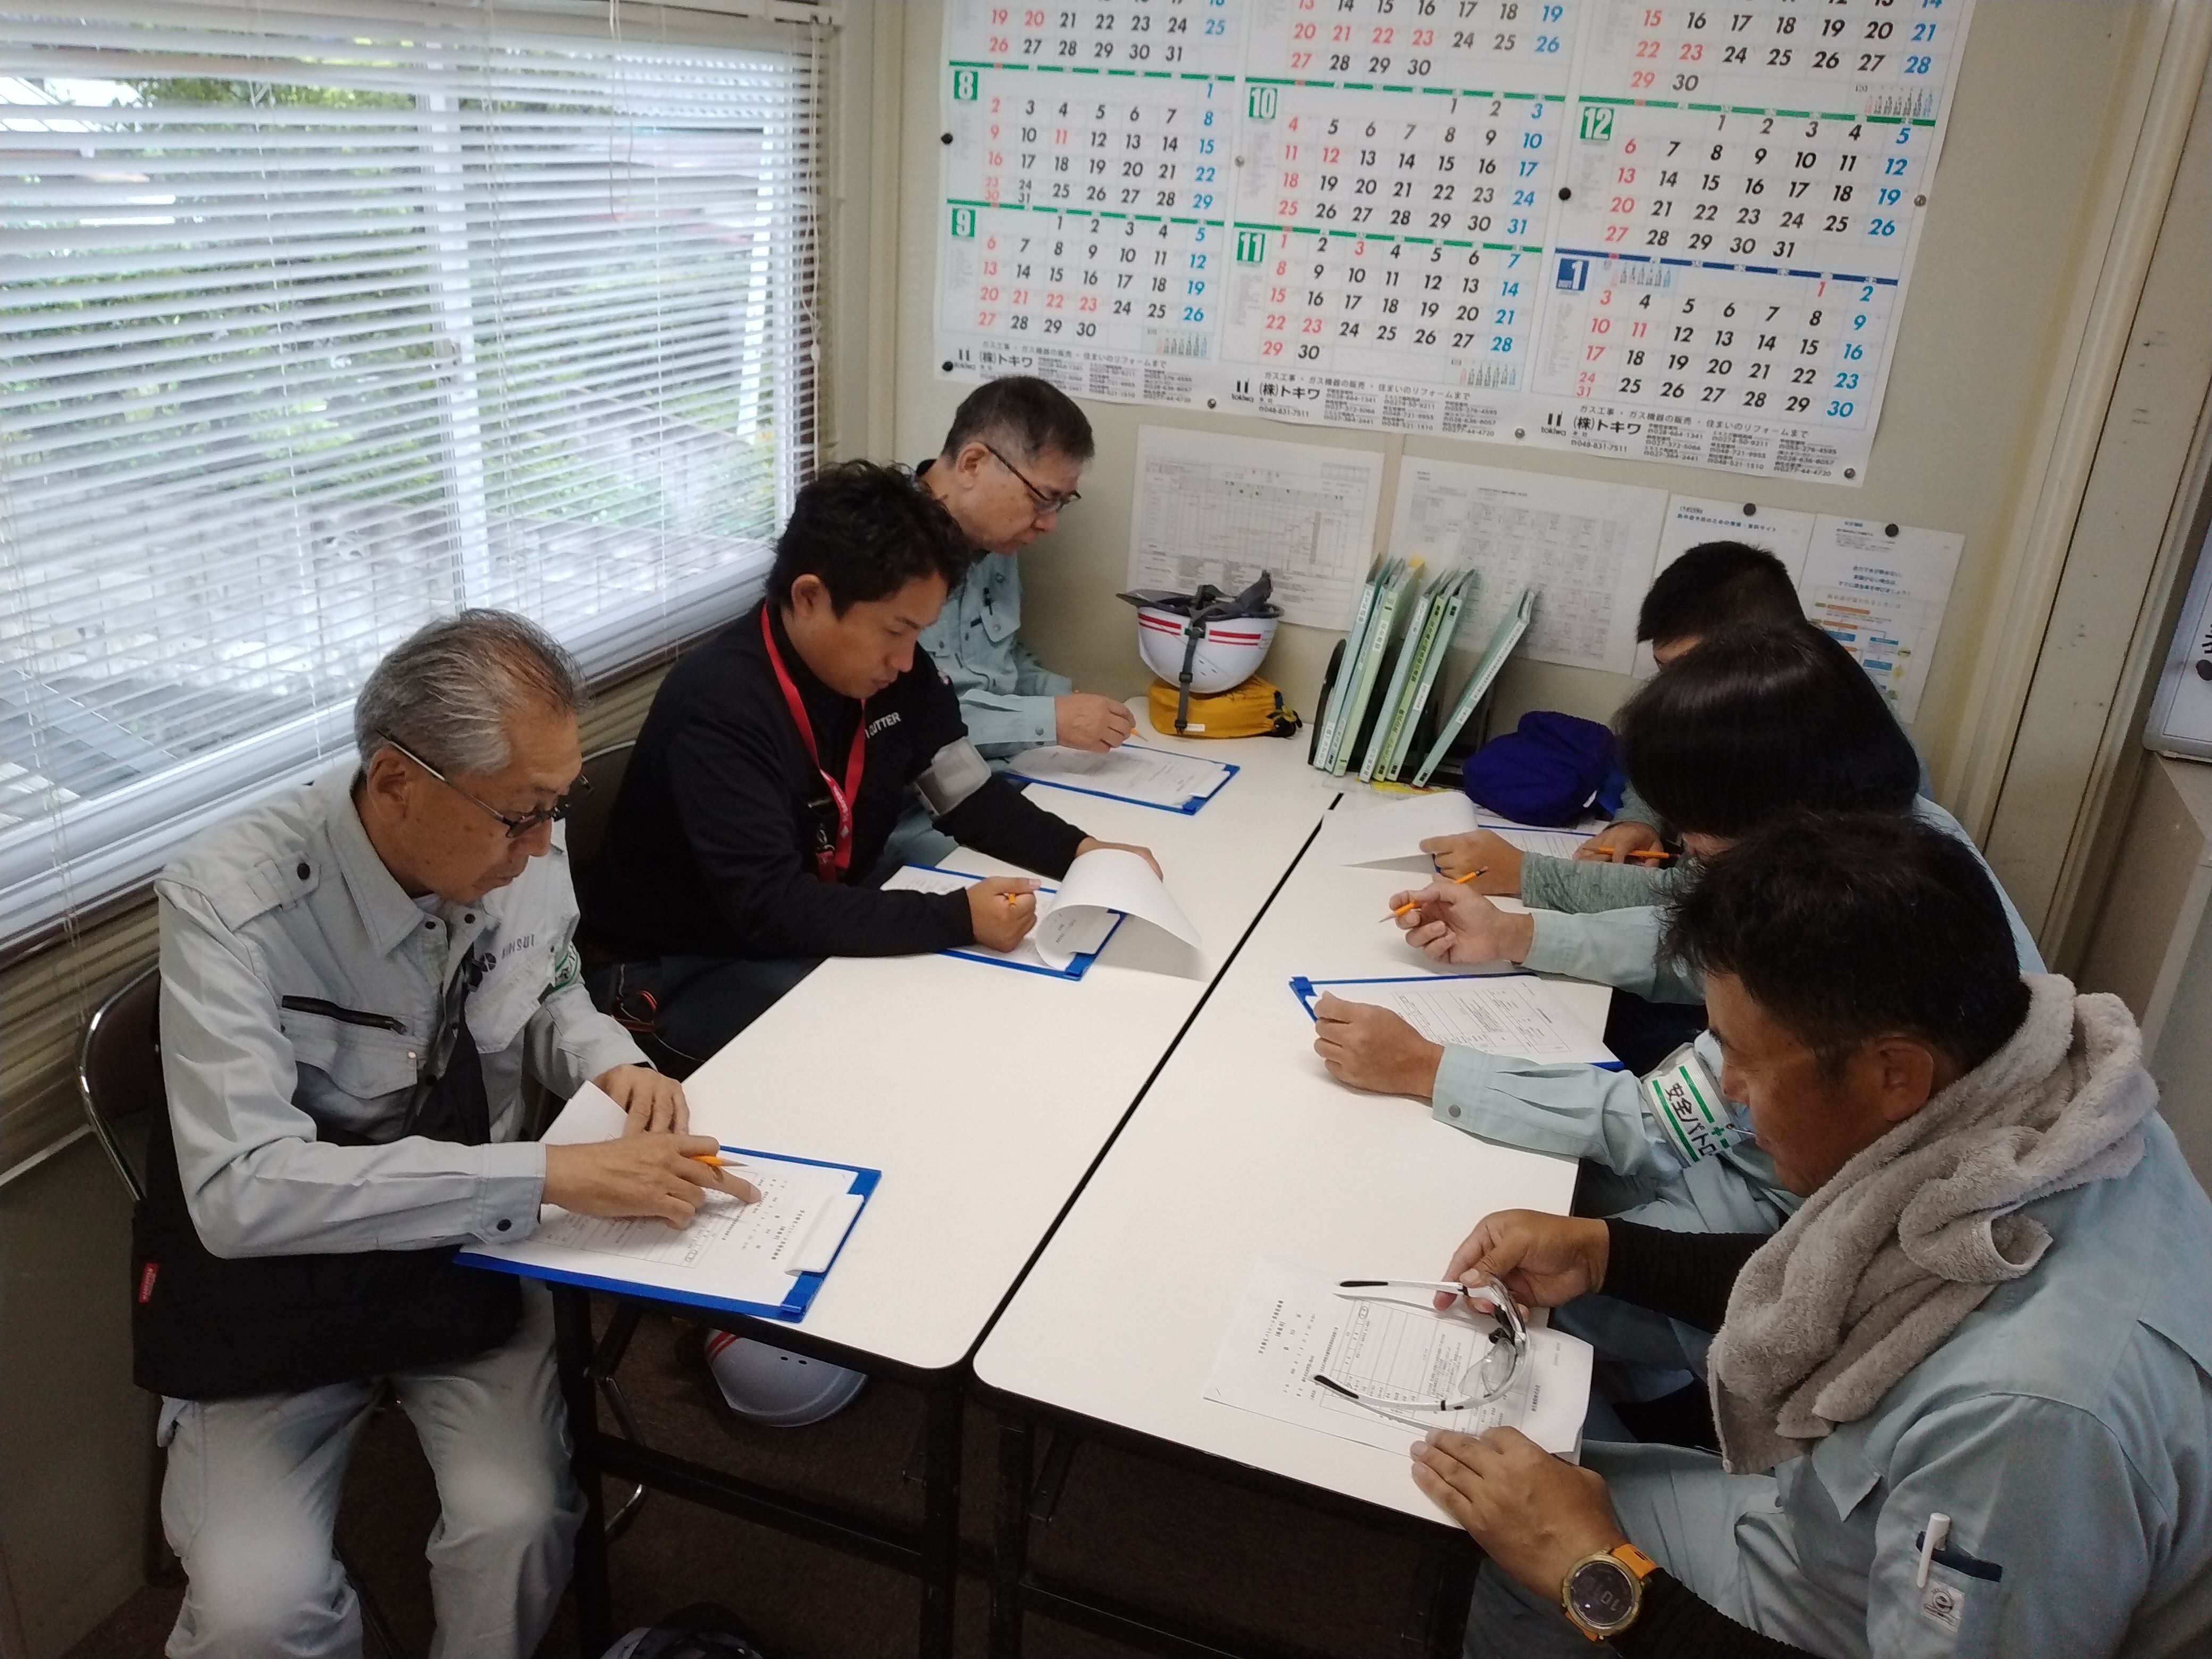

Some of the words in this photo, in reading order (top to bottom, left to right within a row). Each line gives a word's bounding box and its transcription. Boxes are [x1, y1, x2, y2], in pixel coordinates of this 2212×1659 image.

[1644, 9, 1662, 27] 15
[1687, 12, 1706, 29] 16
[1731, 14, 1753, 32] 17
[1776, 16, 1797, 35] 18
[1822, 19, 1845, 37] 19
[1864, 21, 1893, 39] 20
[1912, 23, 1937, 41] 21
[1291, 52, 1313, 69] 27
[1329, 54, 1351, 71] 28
[1369, 56, 1391, 73] 29
[1406, 58, 1431, 76] 30
[958, 71, 975, 99] 8
[991, 97, 1001, 113] 2
[1025, 99, 1035, 115] 3
[1059, 102, 1068, 117] 4
[1095, 104, 1105, 120] 5
[1129, 106, 1140, 122] 6
[1166, 108, 1177, 124] 7
[1203, 111, 1214, 127] 8
[1251, 88, 1276, 118] 10
[1288, 116, 1298, 132] 4
[1328, 119, 1339, 135] 5
[1365, 121, 1376, 138] 6
[1404, 123, 1417, 140] 7
[1444, 127, 1456, 143] 8
[1486, 129, 1497, 146] 9
[1523, 132, 1543, 149] 10
[1583, 108, 1612, 139] 12
[1716, 114, 1727, 131] 1
[1759, 118, 1774, 135] 2
[1805, 121, 1819, 138] 3
[1848, 124, 1862, 141] 4
[1895, 127, 1911, 144] 5
[1624, 138, 1637, 154] 6
[1667, 140, 1681, 157] 7
[1710, 144, 1723, 161] 8
[1754, 148, 1767, 165] 9
[1795, 152, 1817, 169] 10
[1839, 154, 1857, 172] 11
[1885, 158, 1908, 175] 12
[1618, 166, 1636, 183] 13
[1659, 170, 1679, 188] 14
[1702, 173, 1720, 191] 15
[1745, 177, 1764, 195] 16
[1789, 181, 1811, 198] 17
[1833, 185, 1853, 202] 18
[1879, 188, 1901, 206] 19
[956, 209, 971, 237] 9
[1610, 196, 1635, 213] 20
[1650, 199, 1673, 217] 21
[1693, 204, 1718, 221] 22
[1736, 207, 1761, 225] 23
[1779, 211, 1805, 229] 24
[1824, 214, 1849, 232] 25
[1868, 218, 1895, 236] 26
[987, 236, 996, 250] 6
[1020, 238, 1030, 253] 7
[1053, 241, 1063, 256] 8
[1088, 244, 1098, 259] 9
[1119, 248, 1137, 263] 10
[1154, 250, 1167, 265] 11
[1190, 254, 1206, 269] 12
[1239, 233, 1263, 262] 11
[1280, 233, 1288, 249] 1
[1318, 237, 1328, 252] 2
[1354, 241, 1365, 256] 3
[1390, 244, 1401, 258] 4
[1430, 247, 1442, 262] 5
[1469, 250, 1479, 265] 6
[1508, 253, 1521, 268] 7
[1605, 225, 1629, 242] 27
[1646, 229, 1669, 246] 28
[1688, 233, 1713, 250] 29
[1729, 237, 1756, 254] 30
[1772, 241, 1795, 258] 31
[983, 261, 998, 276] 13
[1016, 264, 1031, 279] 14
[1050, 266, 1063, 282] 15
[1084, 270, 1098, 286] 16
[1118, 273, 1133, 289] 17
[1152, 276, 1167, 292] 18
[1188, 280, 1205, 295] 19
[1276, 260, 1287, 276] 8
[1314, 264, 1324, 279] 9
[1348, 267, 1366, 283] 10
[1386, 271, 1399, 287] 11
[1424, 274, 1443, 290] 12
[1462, 277, 1479, 294] 13
[1502, 281, 1519, 297] 14
[1570, 261, 1584, 289] 1
[1817, 281, 1826, 297] 1
[1859, 286, 1874, 302] 2
[980, 286, 1000, 301] 20
[1012, 289, 1029, 304] 21
[1045, 292, 1065, 309] 22
[1079, 296, 1097, 312] 23
[1113, 299, 1132, 315] 24
[1147, 303, 1166, 319] 25
[1184, 307, 1204, 322] 26
[1270, 287, 1286, 303] 15
[1308, 291, 1324, 306] 16
[1345, 295, 1362, 310] 17
[1382, 298, 1399, 314] 18
[1421, 301, 1439, 317] 19
[1456, 305, 1479, 321] 20
[1495, 309, 1515, 325] 21
[1600, 289, 1612, 306] 3
[1639, 294, 1652, 309] 4
[1682, 298, 1695, 314] 5
[1723, 302, 1736, 317] 6
[1765, 306, 1781, 322] 7
[1809, 310, 1823, 326] 8
[1854, 314, 1867, 330] 9
[1591, 317, 1611, 334] 10
[1631, 322, 1647, 338] 11
[1673, 326, 1694, 343] 12
[1715, 330, 1734, 347] 13
[1757, 334, 1777, 351] 14
[1800, 338, 1820, 355] 15
[1844, 343, 1863, 360] 16
[1586, 345, 1606, 361] 17
[1627, 349, 1645, 366] 18
[1668, 354, 1689, 371] 19
[1706, 358, 1732, 375] 20
[1748, 363, 1771, 380] 21
[1791, 367, 1816, 384] 22
[1835, 372, 1859, 390] 23
[1259, 382, 1321, 400] (株)トキワ
[1576, 386, 1592, 397] 31
[1578, 372, 1596, 384] 24
[1619, 377, 1642, 393] 25
[1660, 382, 1685, 398] 26
[1700, 386, 1726, 403] 27
[1743, 391, 1767, 408] 28
[1784, 396, 1811, 412] 29
[1826, 400, 1854, 417] 30
[1572, 415, 1641, 435] (株)トキワ
